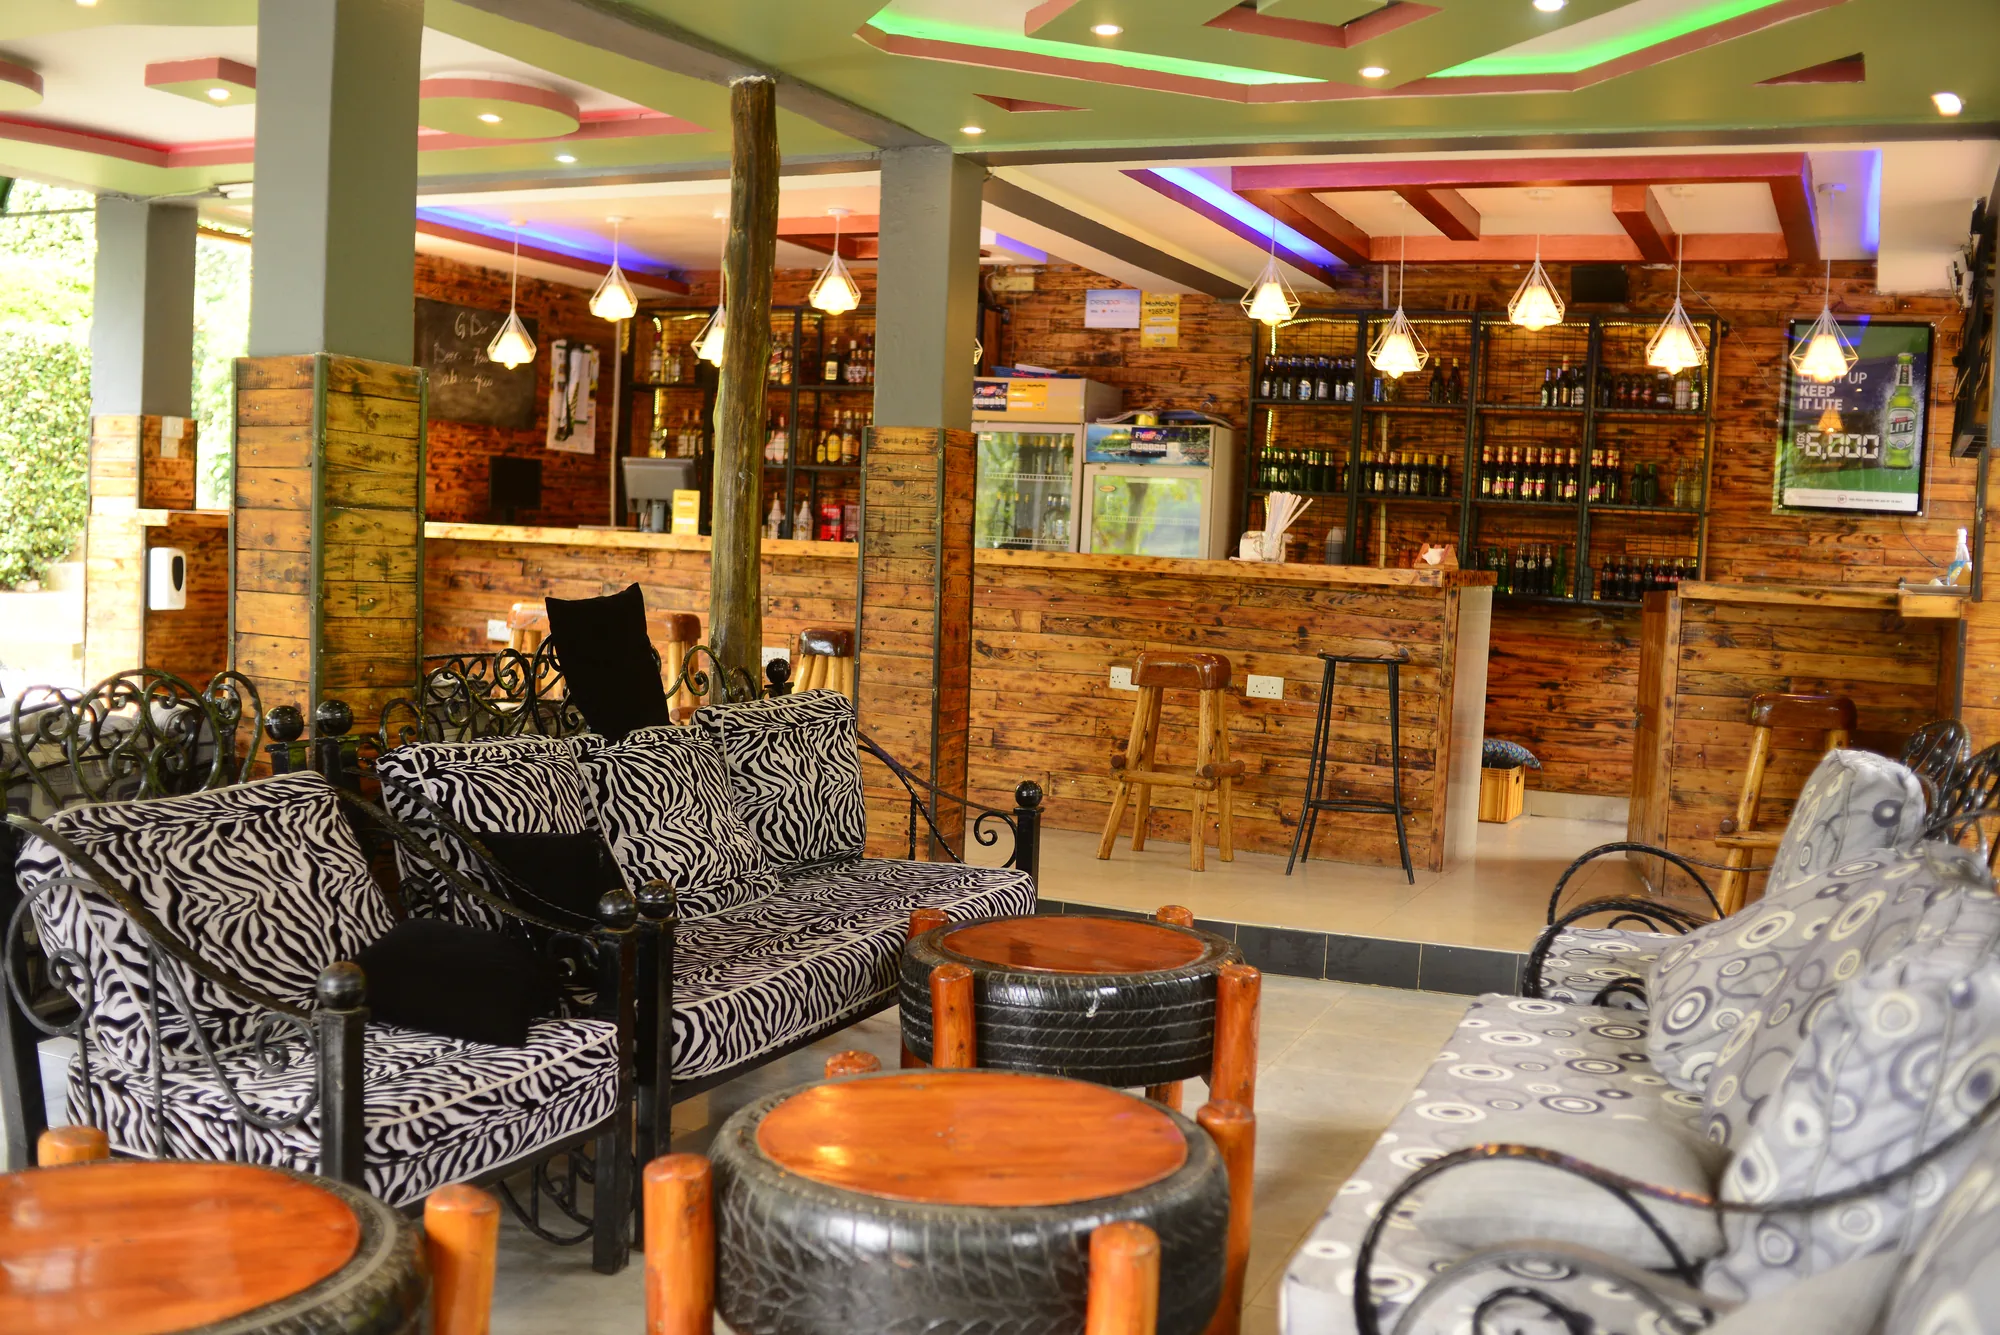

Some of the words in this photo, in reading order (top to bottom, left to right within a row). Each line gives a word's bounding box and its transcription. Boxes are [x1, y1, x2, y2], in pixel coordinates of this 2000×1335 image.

[1848, 371, 1868, 384] UP
[1799, 385, 1835, 397] KEEP
[1799, 398, 1812, 410] IT
[1814, 398, 1843, 411] LITE
[1890, 420, 1914, 433] LITE
[1796, 432, 1806, 449] UGX
[1805, 432, 1879, 460] 6,000
